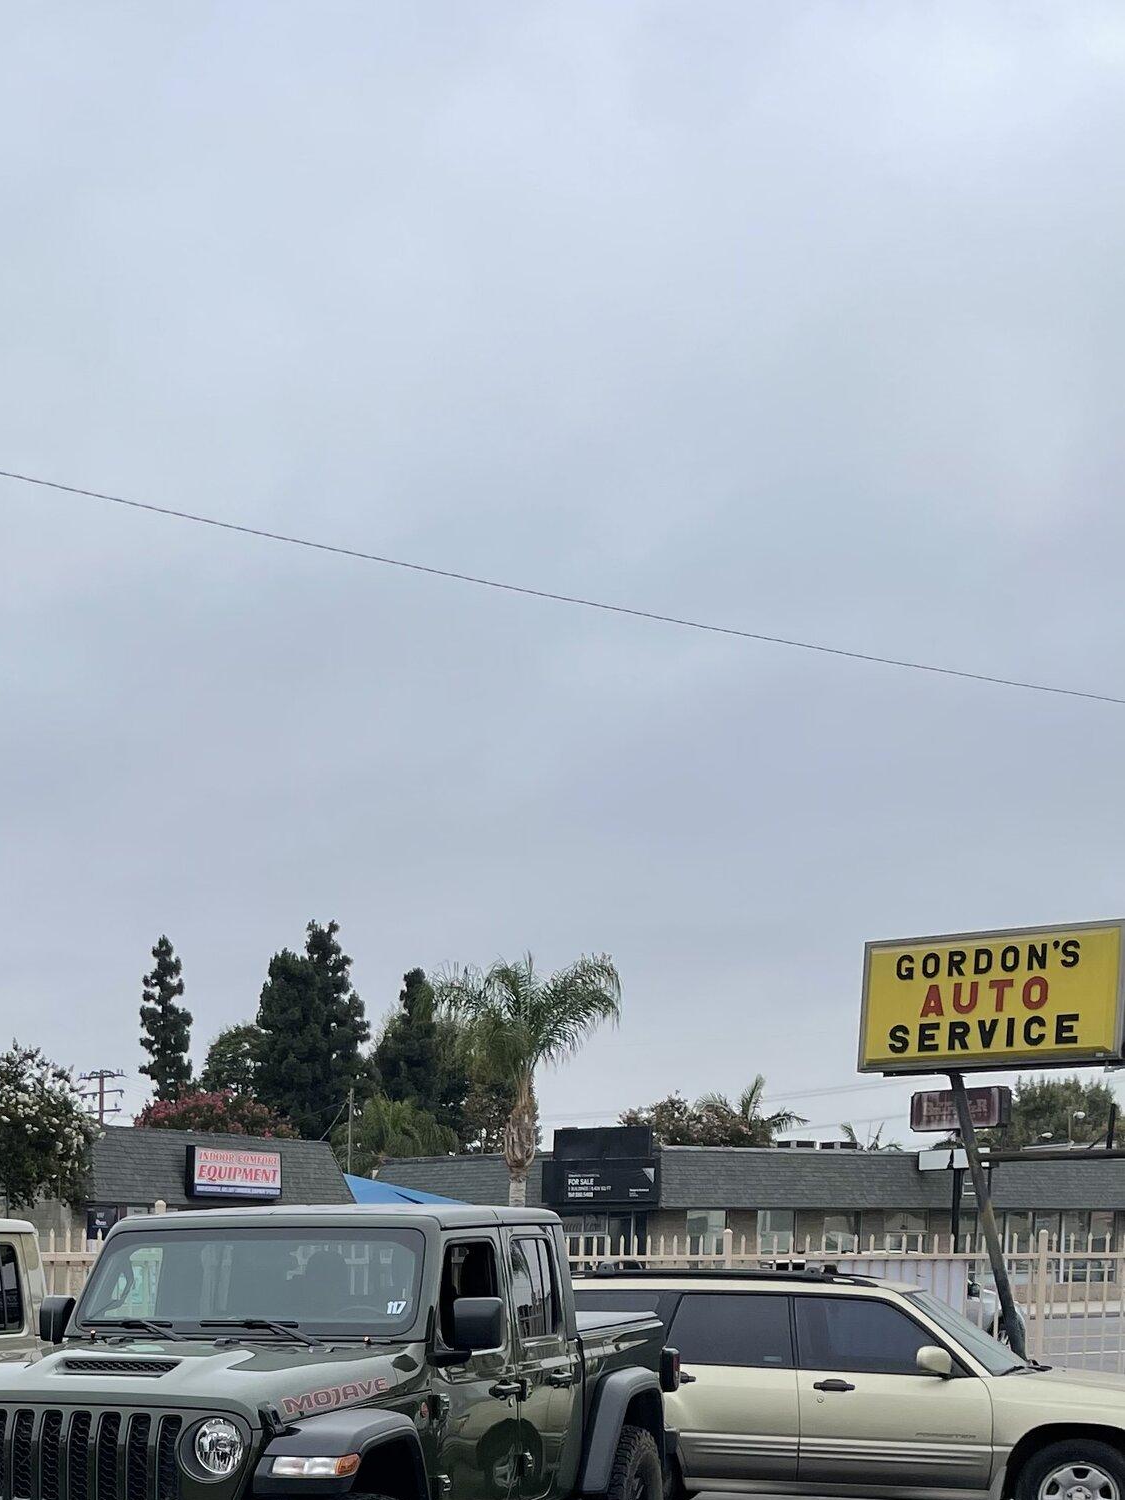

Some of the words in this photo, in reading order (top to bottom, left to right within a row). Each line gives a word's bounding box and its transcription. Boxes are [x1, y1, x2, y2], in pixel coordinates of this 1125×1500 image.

[896, 939, 1081, 981] GORDON'S
[920, 976, 1049, 1018] AUTO
[888, 1013, 1080, 1054] SERVICE
[199, 1151, 235, 1162] INDOOR
[238, 1154, 278, 1165] COMFORT
[198, 1164, 279, 1183] EQUIPMENT
[567, 1178, 579, 1186] FOR
[580, 1178, 594, 1186] SALE
[386, 1300, 407, 1315] 117
[282, 1377, 390, 1415] MOJAVE
